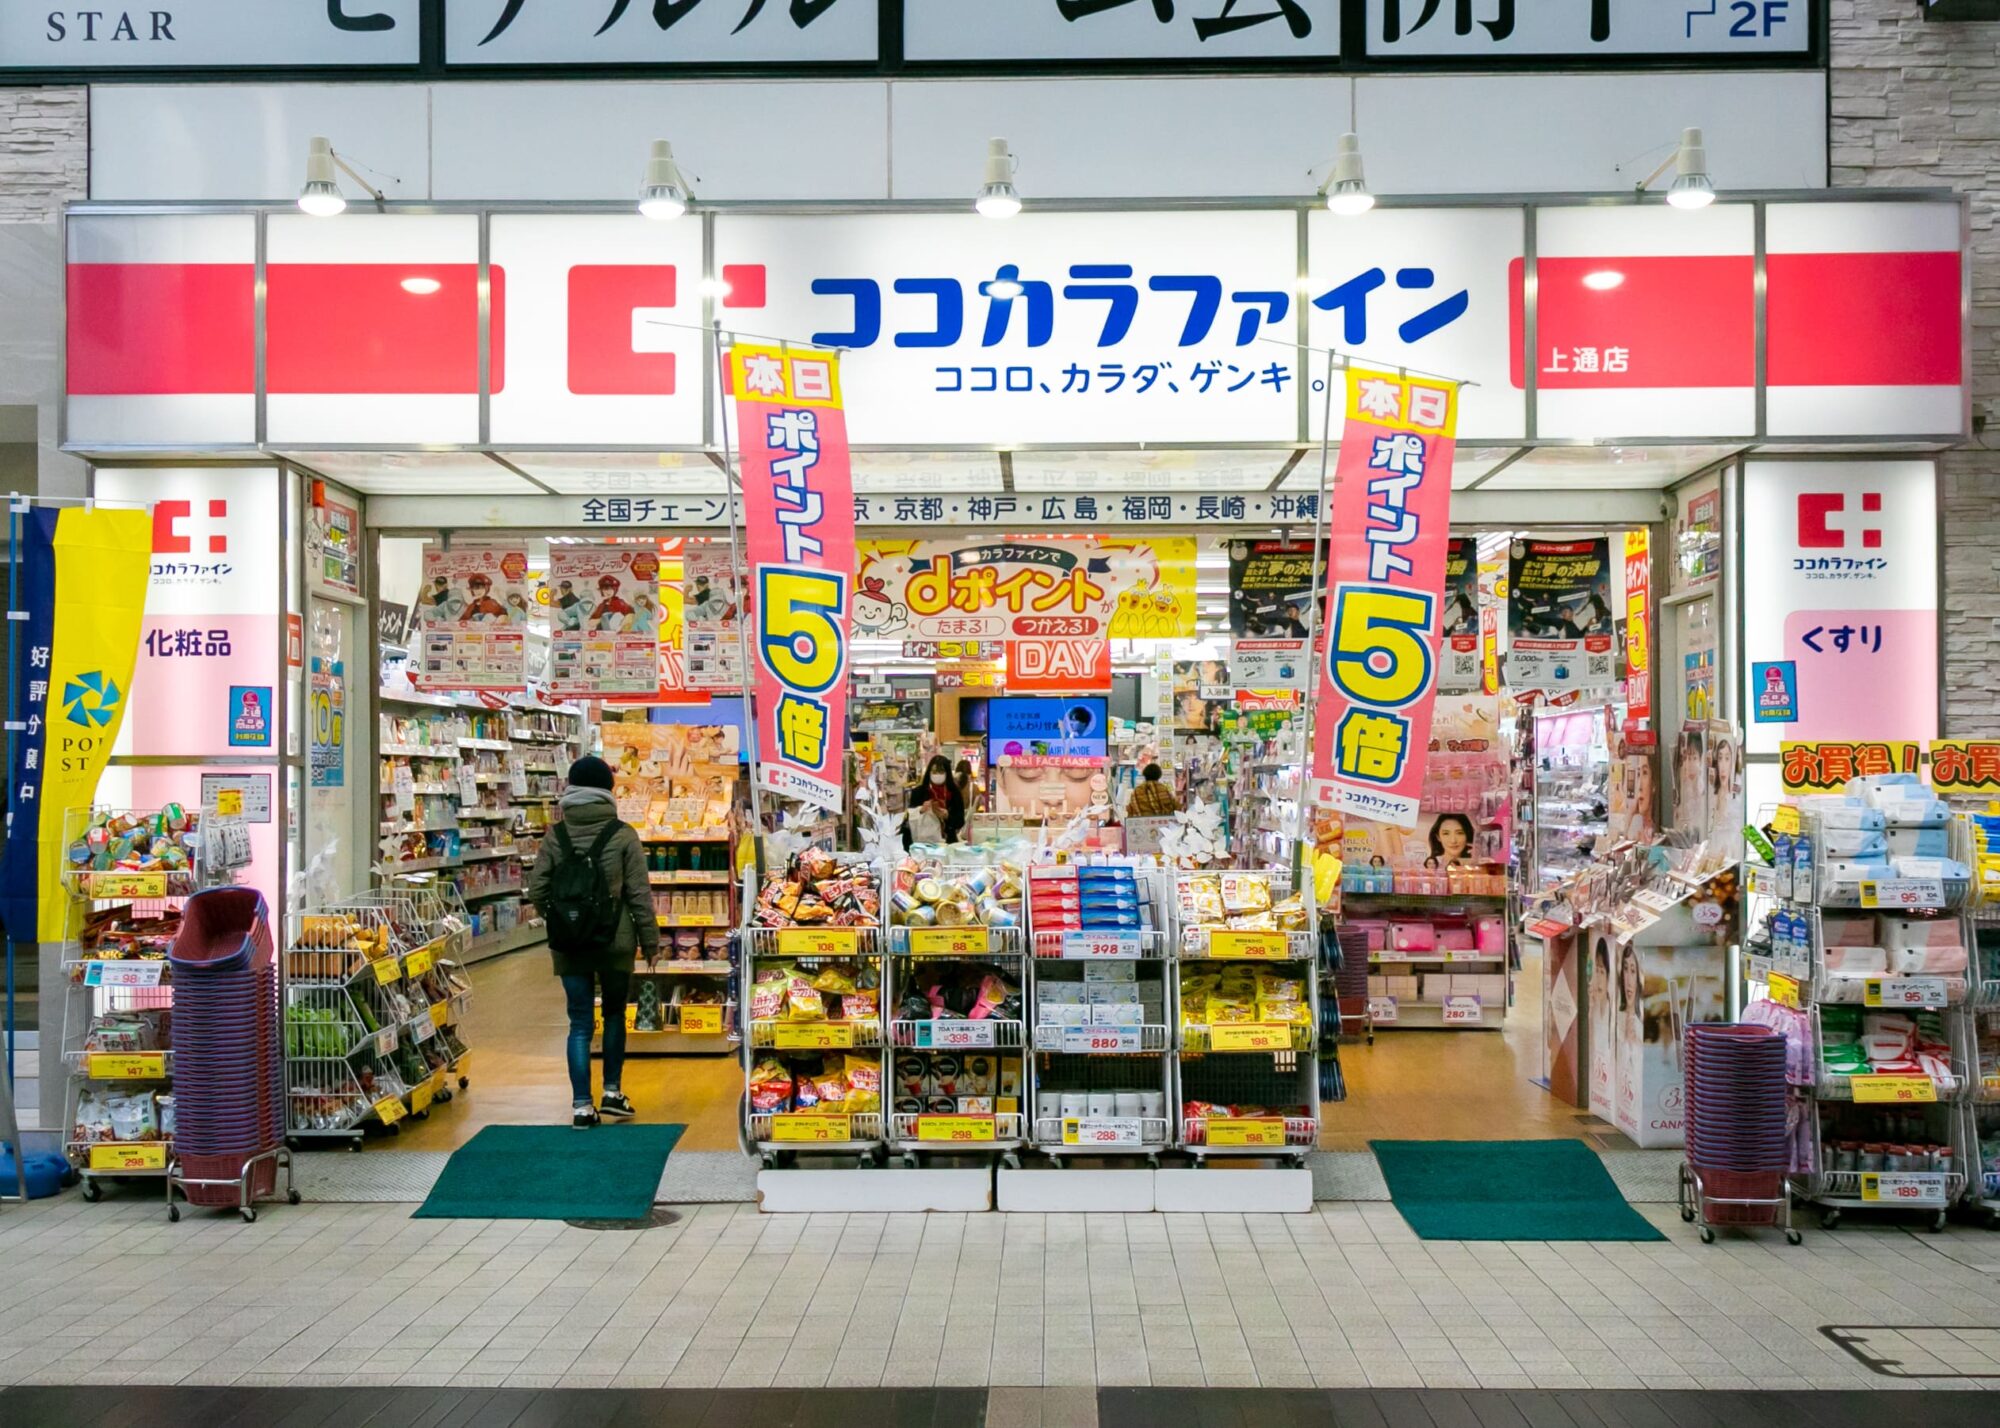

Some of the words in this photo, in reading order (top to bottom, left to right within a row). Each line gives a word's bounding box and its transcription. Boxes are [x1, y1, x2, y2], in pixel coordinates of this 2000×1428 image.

[1729, 1, 1789, 38] 2F
[46, 11, 177, 42] STAR
[811, 264, 1469, 348] ココカラファイン
[1543, 346, 1630, 374] 上通店
[744, 353, 833, 401] 本日
[935, 361, 1325, 394] ココロ、カラダ、ゲンキ。
[1358, 378, 1449, 429] 本日
[961, 548, 1062, 563] カラファインで
[1793, 557, 1888, 570] ココカラファイン
[148, 563, 233, 576] コカラファイン
[905, 554, 1104, 616] dポイント
[1021, 618, 1090, 634] つかえる!
[145, 628, 232, 657] 化粧品
[1801, 625, 1883, 653] くすり
[1015, 640, 1104, 680] DAY
[1036, 757, 1061, 765] FACE
[1062, 757, 1091, 765] MASK
[1345, 791, 1410, 813] ココカラファイン
[120, 884, 139, 895] 56
[1900, 892, 1917, 903] 95
[817, 943, 834, 951] 108
[952, 943, 967, 951] 88
[1092, 944, 1118, 954] 398
[1245, 946, 1266, 955] 298
[122, 974, 138, 983] 98
[1904, 991, 1921, 1002] 95
[684, 1019, 703, 1030] 598
[817, 1036, 831, 1045] 73
[948, 1033, 969, 1043] 398
[1091, 1038, 1118, 1048] 880
[1250, 1037, 1268, 1045] 198
[127, 1066, 143, 1075] 147
[1897, 1089, 1912, 1098] 98
[1650, 1120, 1686, 1129] CANM
[814, 1129, 828, 1138] 73
[952, 1130, 972, 1138] 298
[1096, 1130, 1116, 1140] 288
[1245, 1133, 1263, 1141] 198
[125, 1158, 144, 1167] 298
[1897, 1186, 1919, 1197] 189
